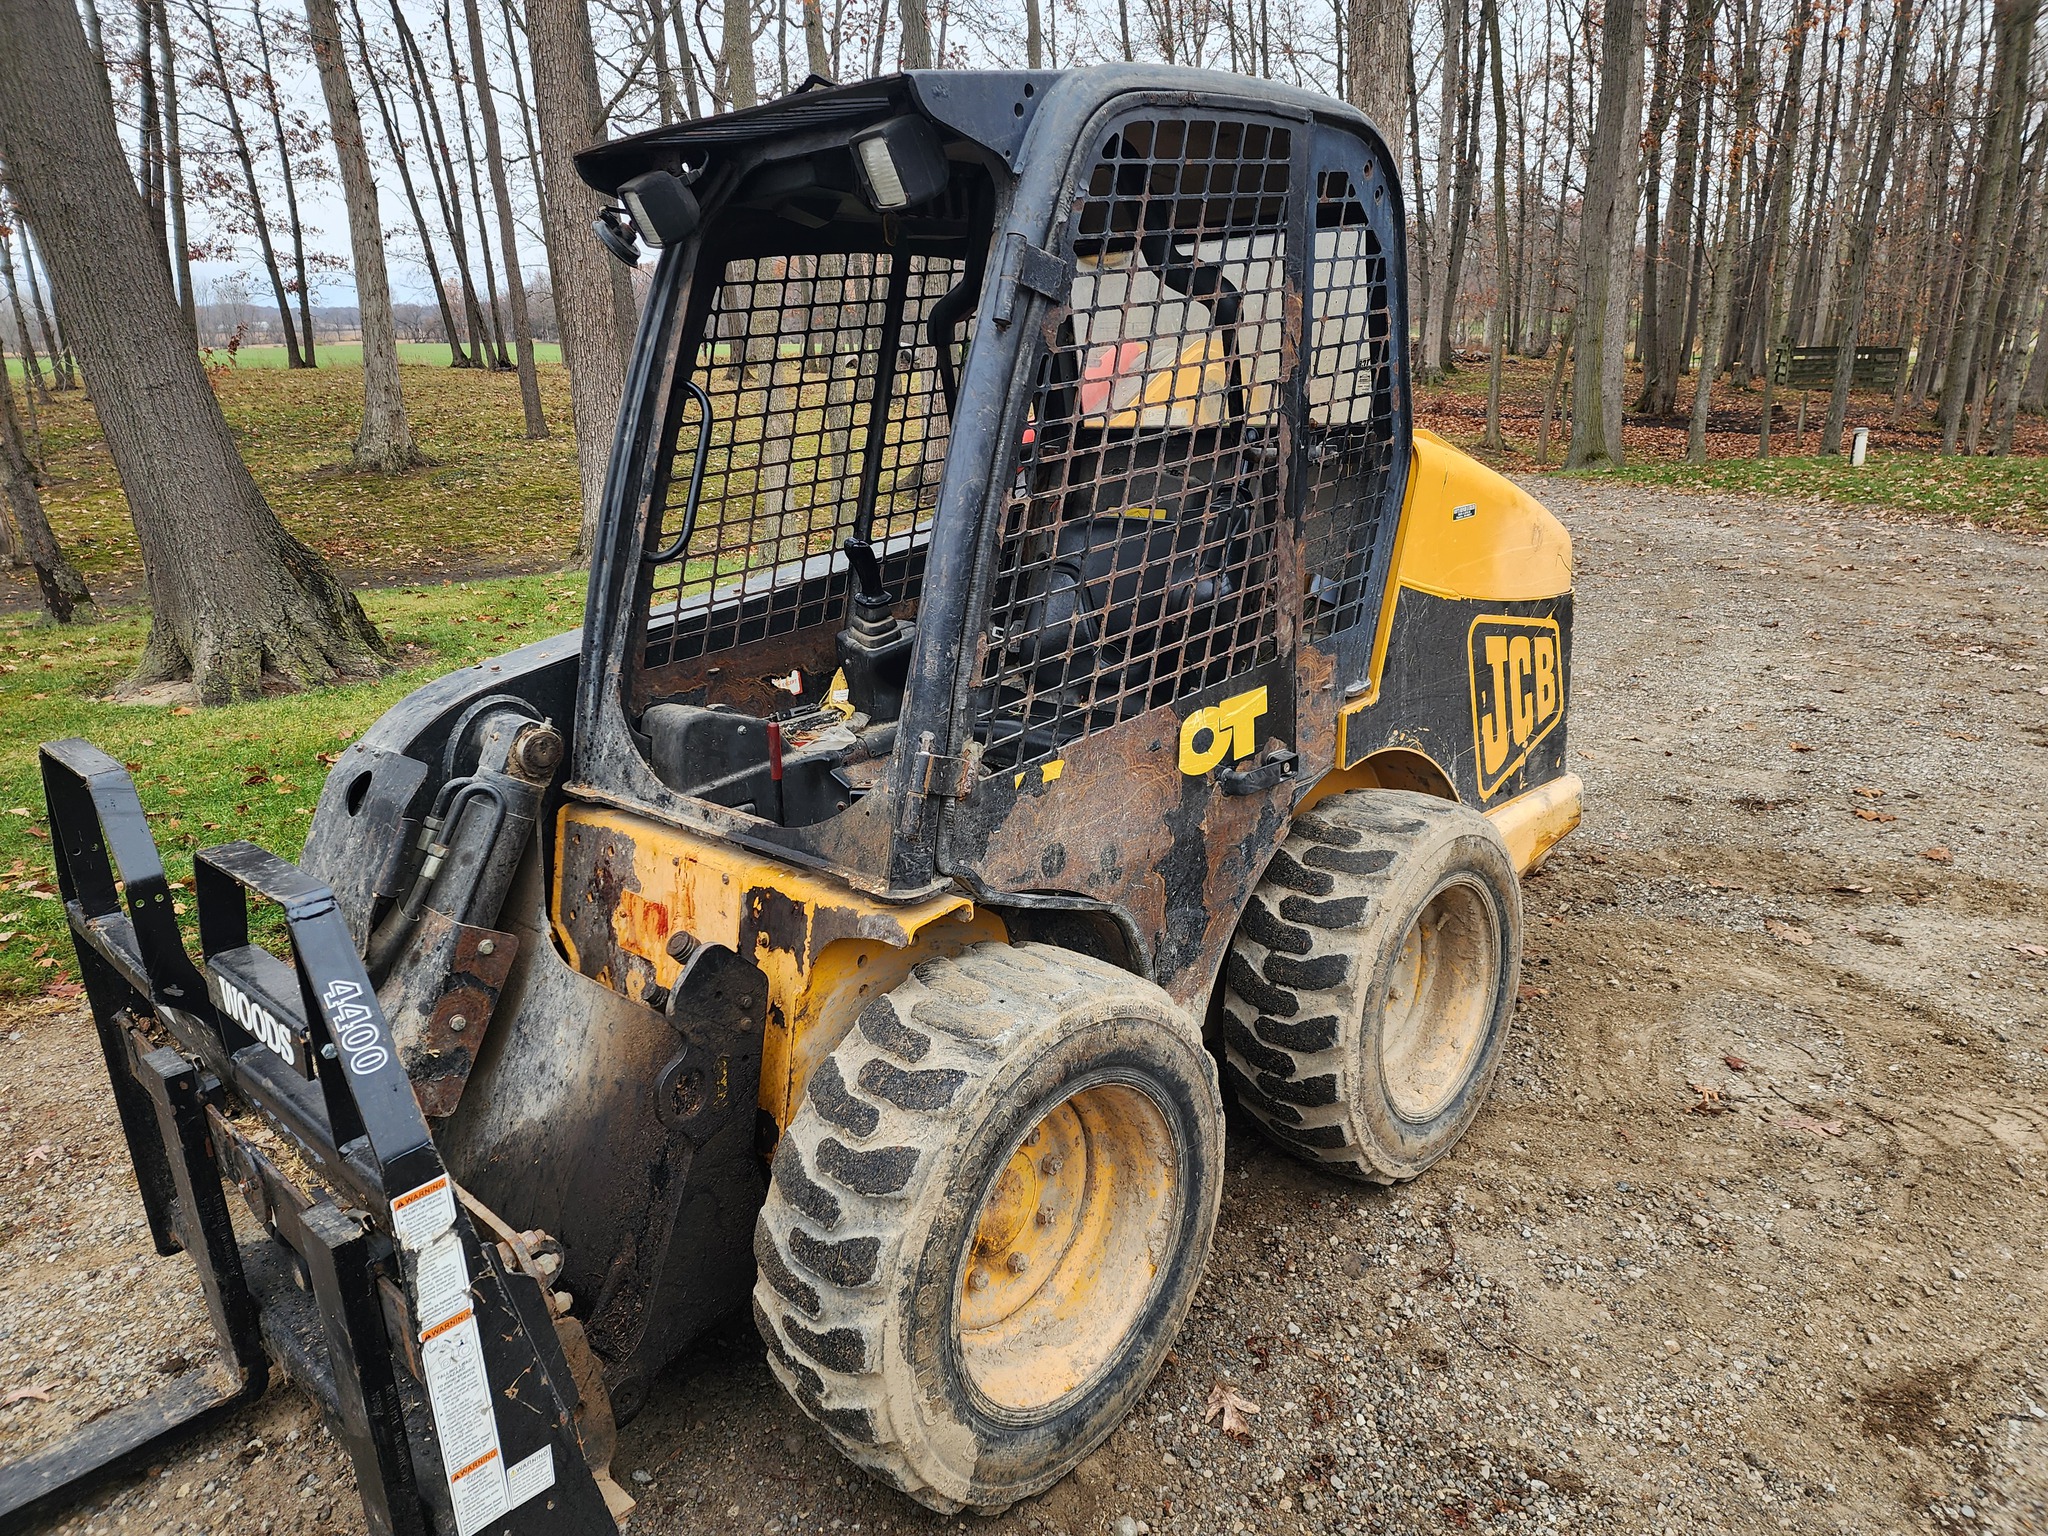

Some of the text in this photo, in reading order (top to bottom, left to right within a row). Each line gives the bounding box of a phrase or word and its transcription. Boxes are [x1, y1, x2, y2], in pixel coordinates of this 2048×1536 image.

[1482, 635, 1556, 775] JCB
[218, 975, 295, 1066] WOODS
[323, 980, 389, 1075] 4400
[406, 1181, 445, 1204] WARNING
[461, 1451, 496, 1476] WARNING
[516, 1450, 548, 1472] WARNING
